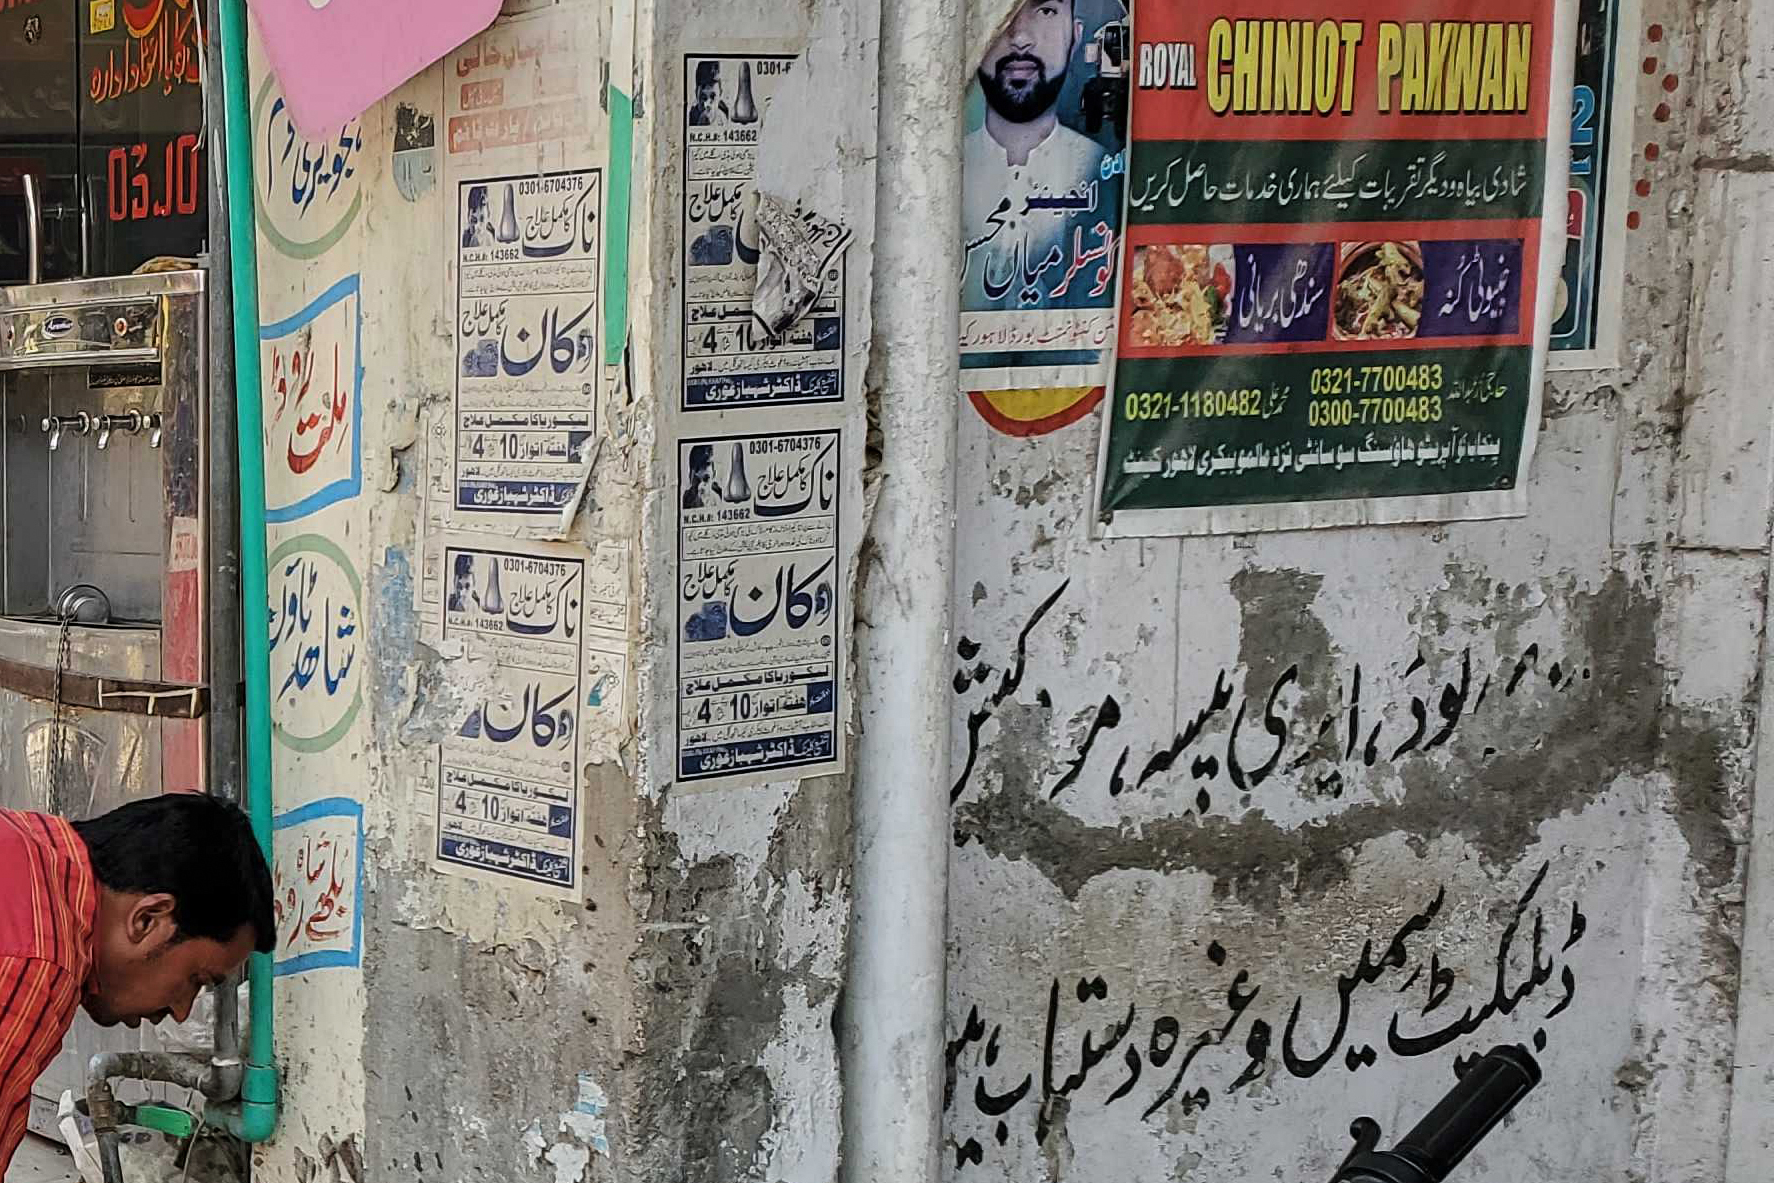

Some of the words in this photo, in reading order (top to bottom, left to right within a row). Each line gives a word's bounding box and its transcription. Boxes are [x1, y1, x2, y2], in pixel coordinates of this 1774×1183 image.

[1138, 42, 1198, 88] ROYAL
[1207, 17, 1363, 115] CHINIOT
[1376, 21, 1533, 115] PAKWAN
[723, 129, 758, 142] 143662
[519, 177, 583, 195] 0301-6704376
[1129, 157, 1183, 213] کریں
[1168, 159, 1218, 207] حاصل
[1218, 171, 1278, 202] خدمات
[1278, 167, 1321, 206] ہماری
[1358, 156, 1426, 212] تقریبات
[1456, 169, 1482, 207] بیاہ
[1483, 164, 1527, 203] شادی
[522, 176, 597, 257] ناک
[540, 193, 575, 240] مکمل
[688, 182, 722, 223] علاج
[708, 182, 747, 223] مکمل
[525, 205, 550, 241] علاج
[983, 230, 1063, 305] میاں
[461, 300, 489, 338] علاج
[477, 298, 510, 337] مکمل
[972, 326, 1008, 346] لاہور
[501, 300, 595, 377] کان
[702, 325, 719, 354] 4
[769, 374, 802, 398] ڈاکٹر
[1310, 364, 1443, 396] 0321-7700483
[287, 341, 349, 475] ملت
[462, 413, 486, 429] علاج
[1125, 389, 1262, 421] 0321-1180482
[1309, 395, 1443, 428] 0300-7700483
[472, 433, 486, 459] 4
[499, 433, 519, 460] 10
[749, 437, 821, 455] 0301-6704376
[1123, 446, 1163, 480] کینٹ
[1161, 444, 1198, 479] لاہور
[1467, 431, 1501, 468] پنجاب
[753, 437, 836, 518] ناک
[756, 461, 786, 501] علاج
[773, 453, 812, 500] مکمل
[717, 508, 751, 521] 143662
[503, 557, 567, 577] 0301-6704376
[683, 561, 715, 602] علاج
[701, 558, 740, 600] مکمل
[506, 566, 581, 639] ناک
[509, 582, 534, 617] علاج
[523, 578, 558, 619] مکمل
[729, 555, 835, 638] کان
[685, 678, 712, 696] علاج
[711, 672, 764, 693] مکمل
[483, 681, 576, 748] کان
[697, 697, 712, 724] 4
[729, 692, 751, 721] 10
[752, 698, 780, 718] اتوار
[763, 737, 795, 763] ڈاکٹر
[455, 790, 468, 814] 4
[482, 794, 500, 821] 10
[1141, 940, 1272, 1121] وغیرہ
[975, 977, 1143, 1147] دستیاب
